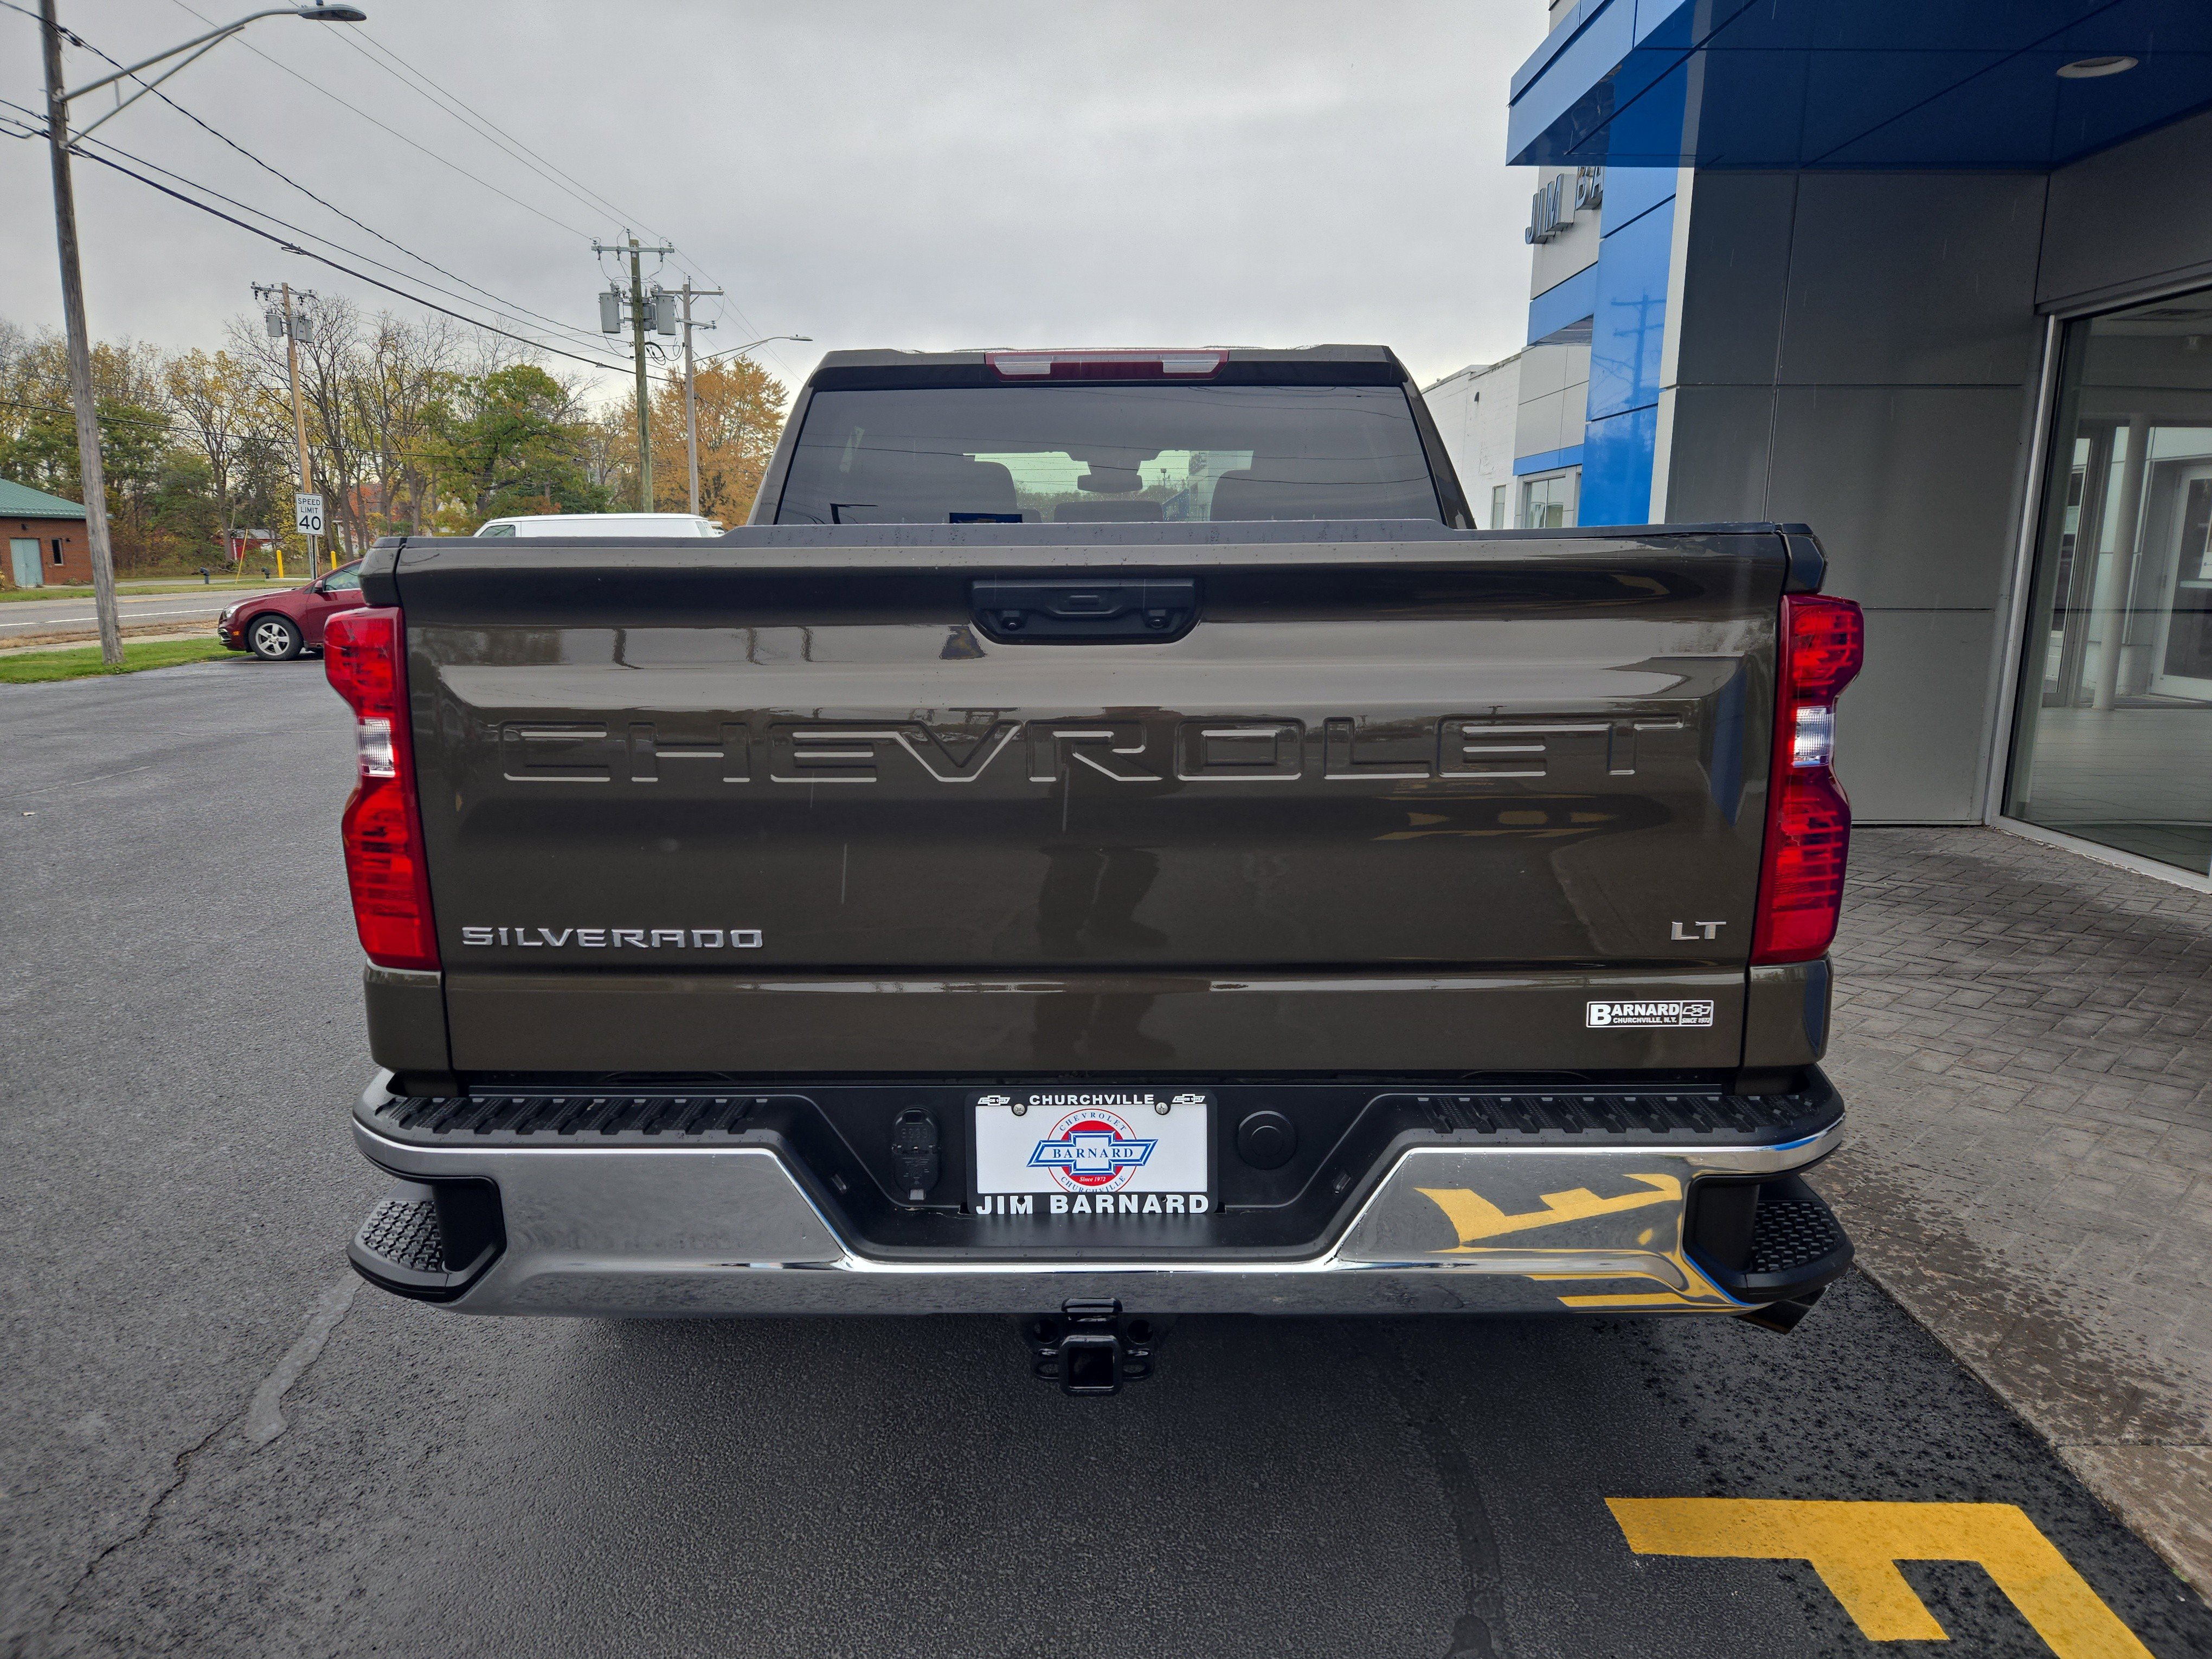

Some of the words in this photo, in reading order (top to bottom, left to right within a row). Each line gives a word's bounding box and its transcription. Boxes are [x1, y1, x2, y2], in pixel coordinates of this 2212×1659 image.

[1525, 173, 1567, 244] JIM
[298, 498, 320, 506] SPEED
[299, 515, 321, 531] 40
[499, 713, 1684, 782] CHEVROLET
[462, 927, 763, 948] SILVERADO
[1671, 922, 1727, 940] LT
[1590, 1004, 1680, 1025] BARNARD
[1029, 1094, 1154, 1105] CHURCHVILLE
[1059, 1112, 1127, 1131] CHEVROLET
[1053, 1148, 1134, 1159] BARNARD
[976, 1195, 1033, 1214] JIM
[1050, 1194, 1208, 1214] BARNARD
